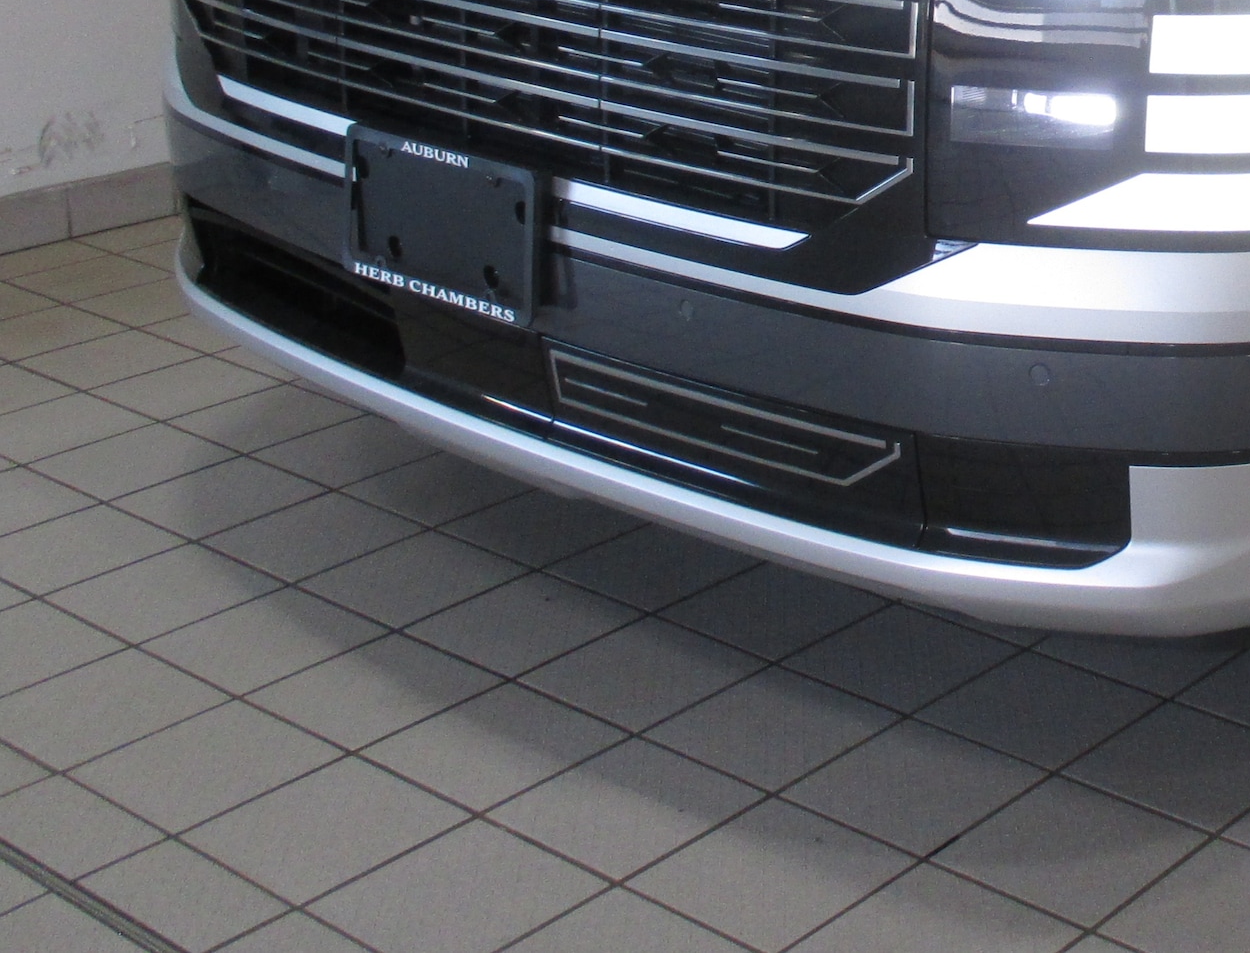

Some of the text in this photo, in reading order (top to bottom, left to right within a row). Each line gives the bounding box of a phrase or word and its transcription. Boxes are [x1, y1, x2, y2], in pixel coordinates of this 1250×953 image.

[401, 141, 469, 168] AUBURN
[354, 262, 515, 323] HERB CHAMBERS
